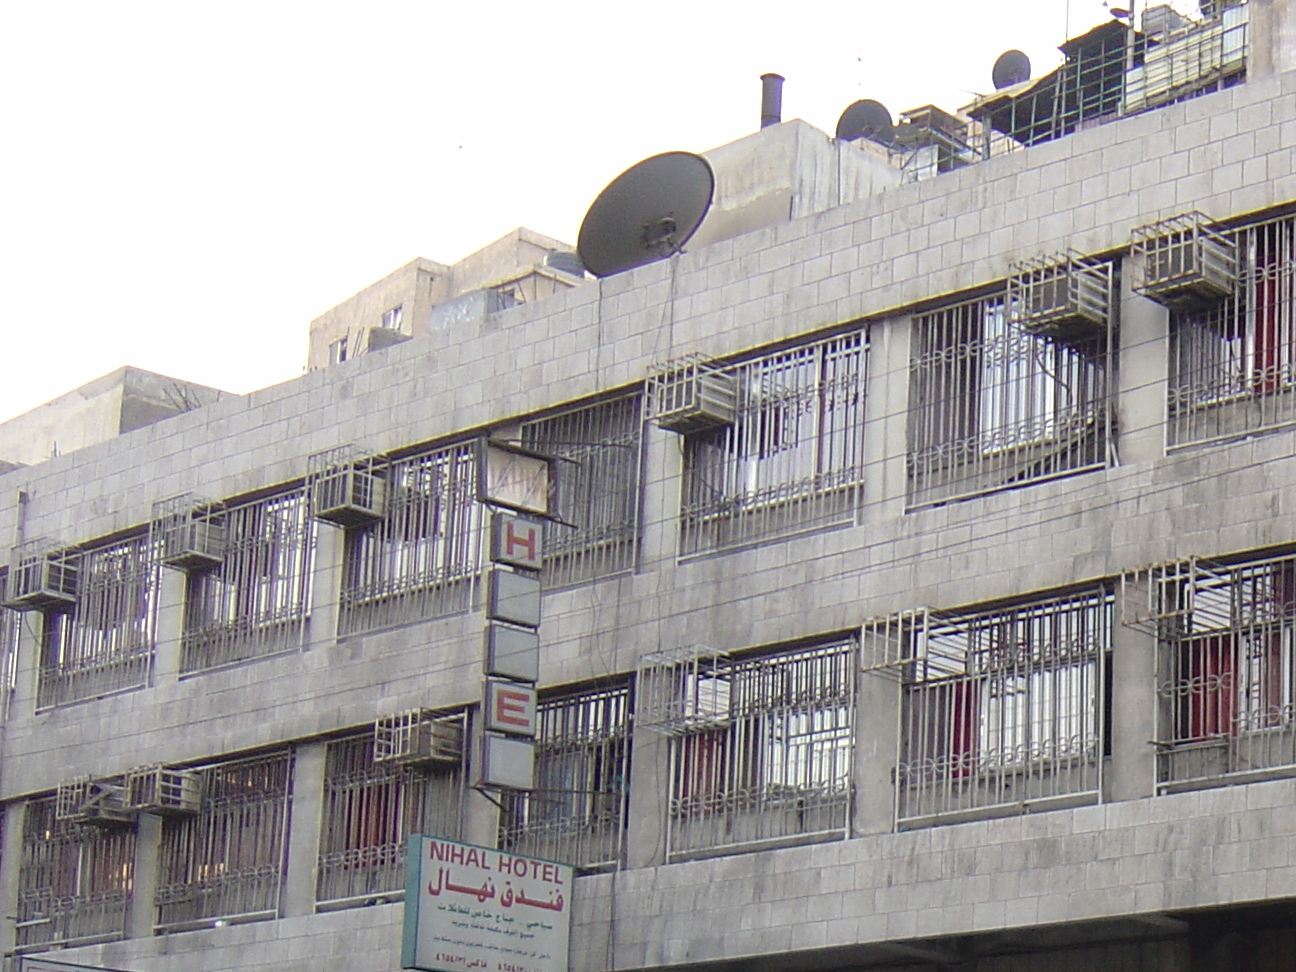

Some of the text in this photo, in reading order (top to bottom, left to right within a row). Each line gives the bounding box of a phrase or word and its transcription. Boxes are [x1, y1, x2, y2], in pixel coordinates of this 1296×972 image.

[430, 841, 564, 885] NIHAL HOTEL
[428, 867, 564, 912] فندق نهال
